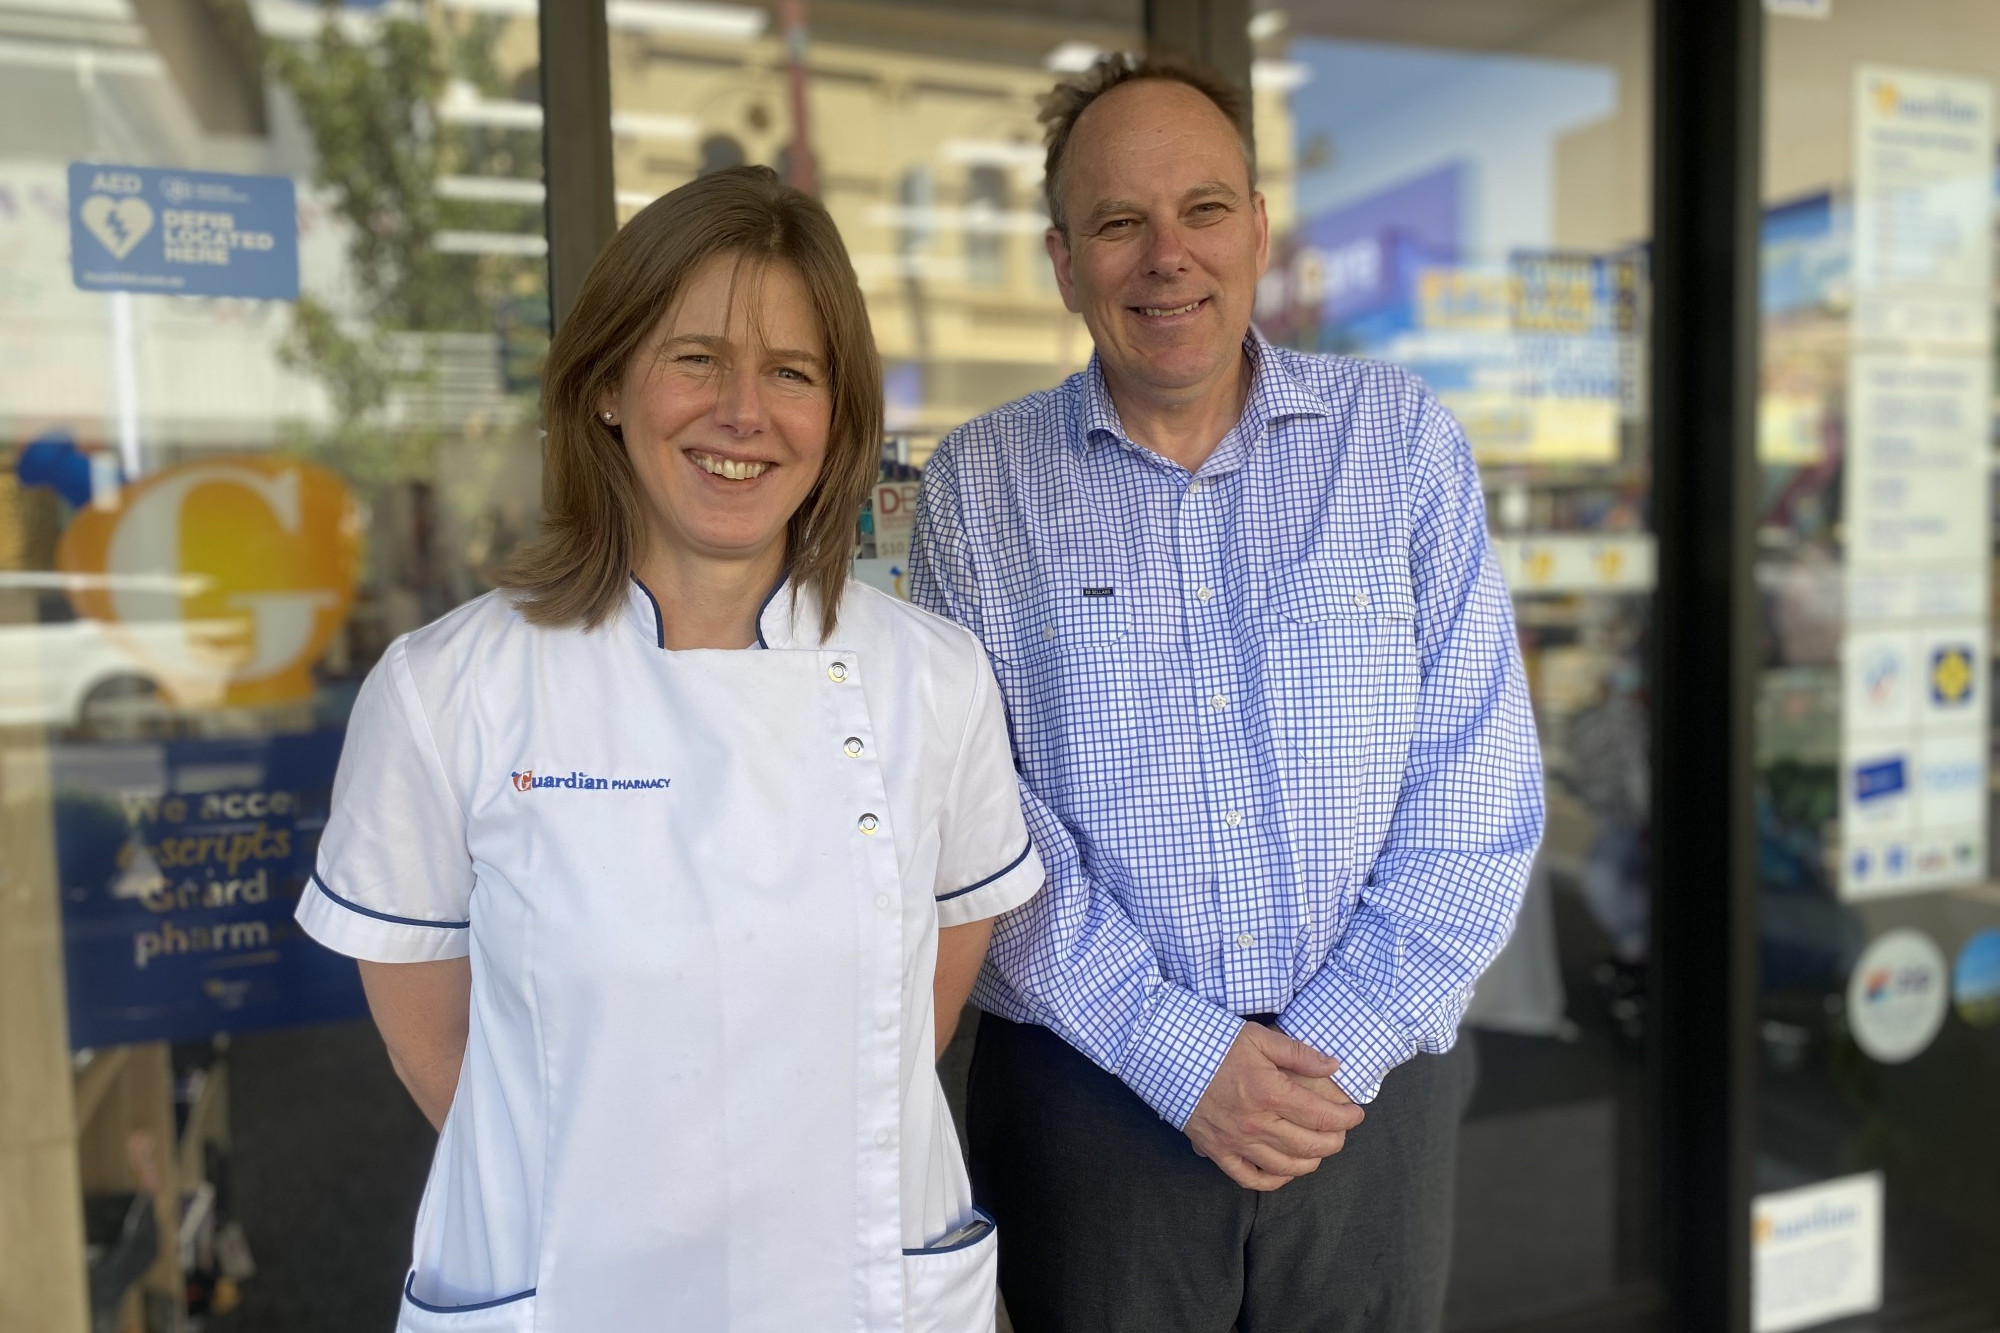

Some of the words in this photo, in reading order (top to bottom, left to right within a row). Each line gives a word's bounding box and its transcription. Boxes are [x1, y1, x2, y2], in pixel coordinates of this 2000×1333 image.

[92, 173, 142, 194] AED
[163, 230, 274, 250] LOCATED
[164, 248, 230, 265] HERE
[511, 769, 609, 792] Guardian
[612, 778, 671, 790] PHARMACY
[200, 790, 294, 821] acce
[134, 921, 269, 969] pharm
